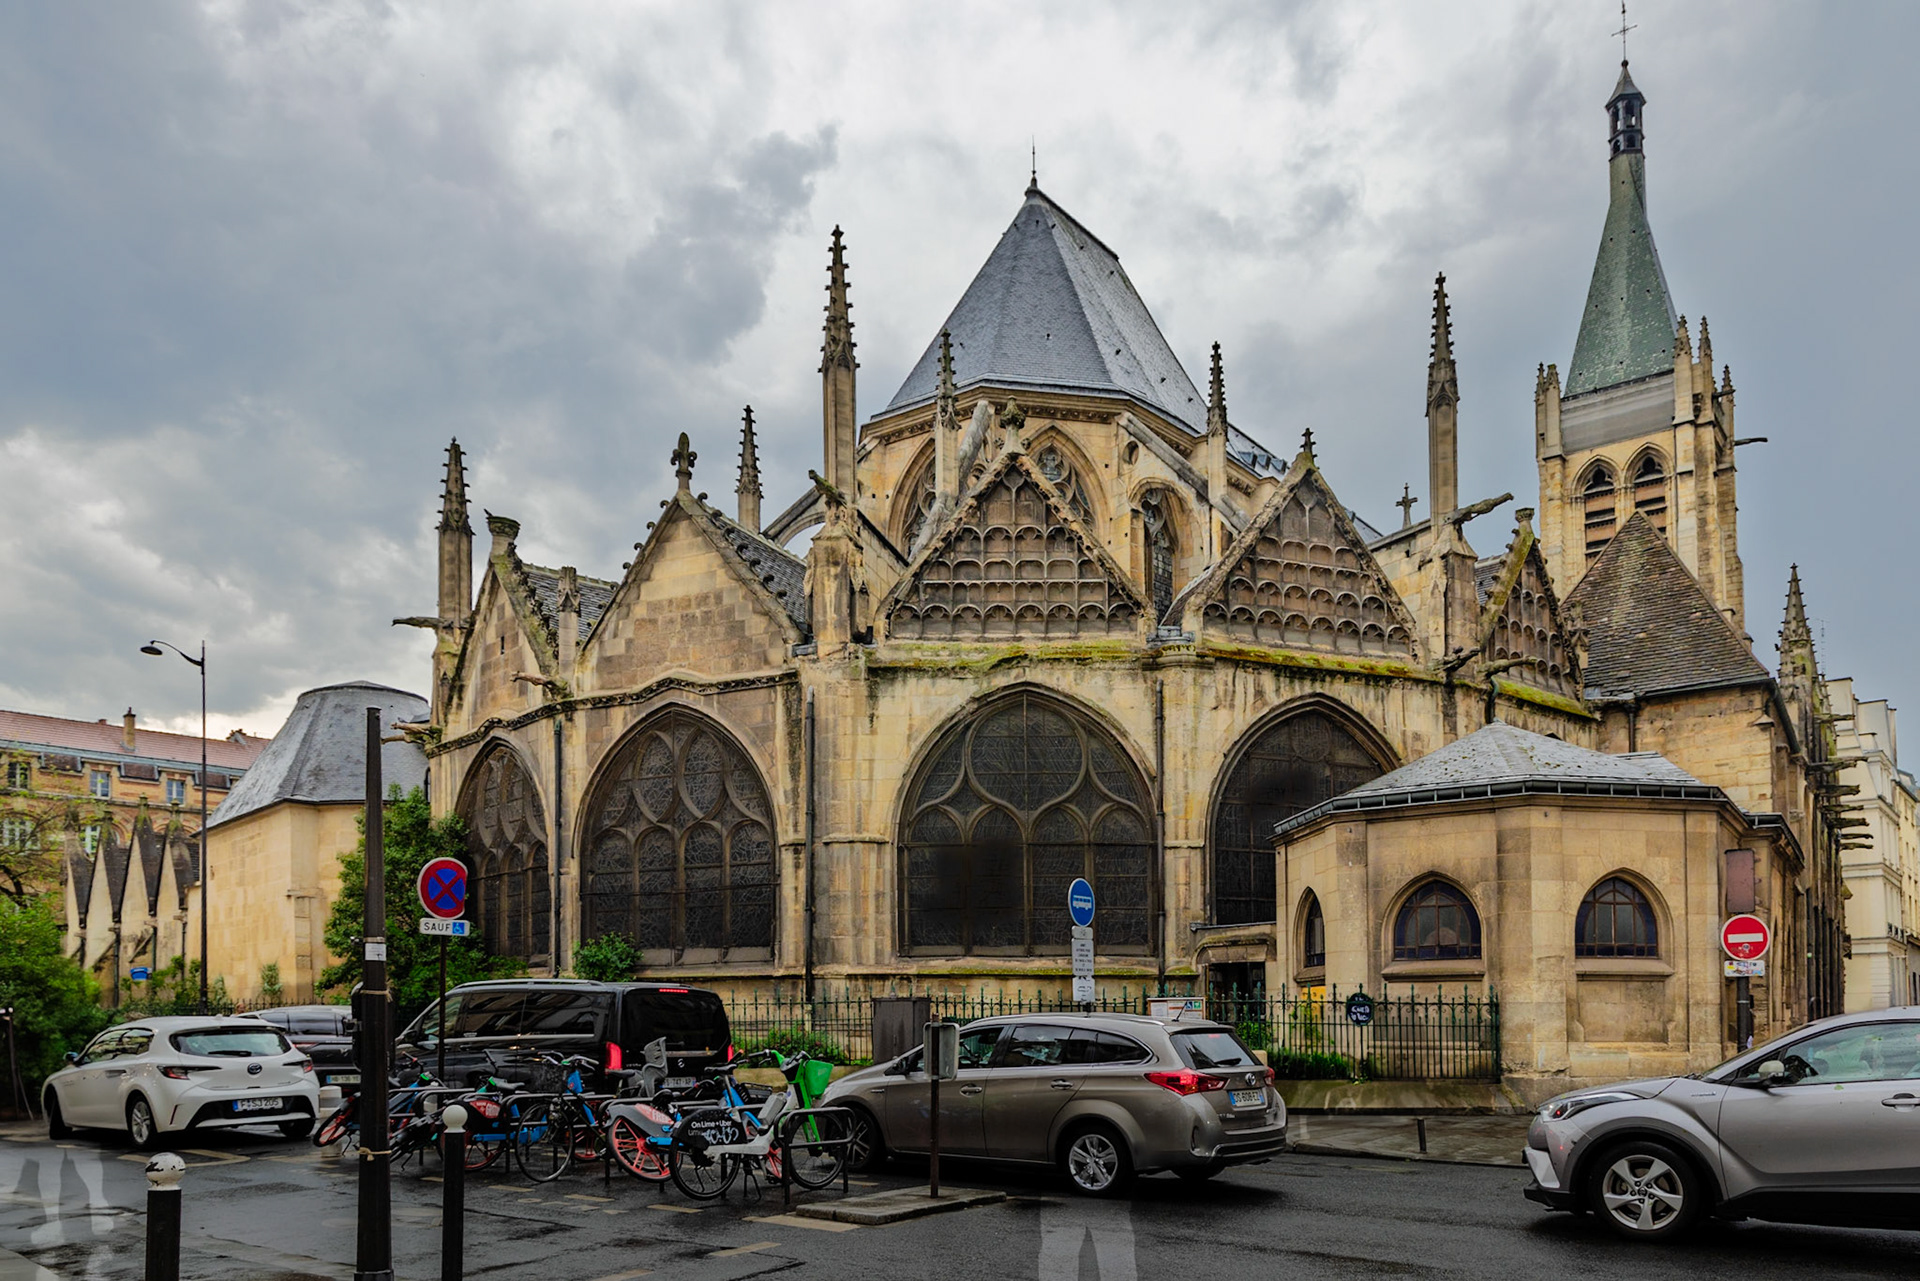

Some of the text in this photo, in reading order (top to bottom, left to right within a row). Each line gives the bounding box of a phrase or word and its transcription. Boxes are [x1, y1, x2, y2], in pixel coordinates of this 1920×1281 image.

[423, 921, 451, 932] SAUF
[691, 1121, 702, 1129] On
[701, 1120, 716, 1128] Lime
[719, 1119, 732, 1127] Uber
